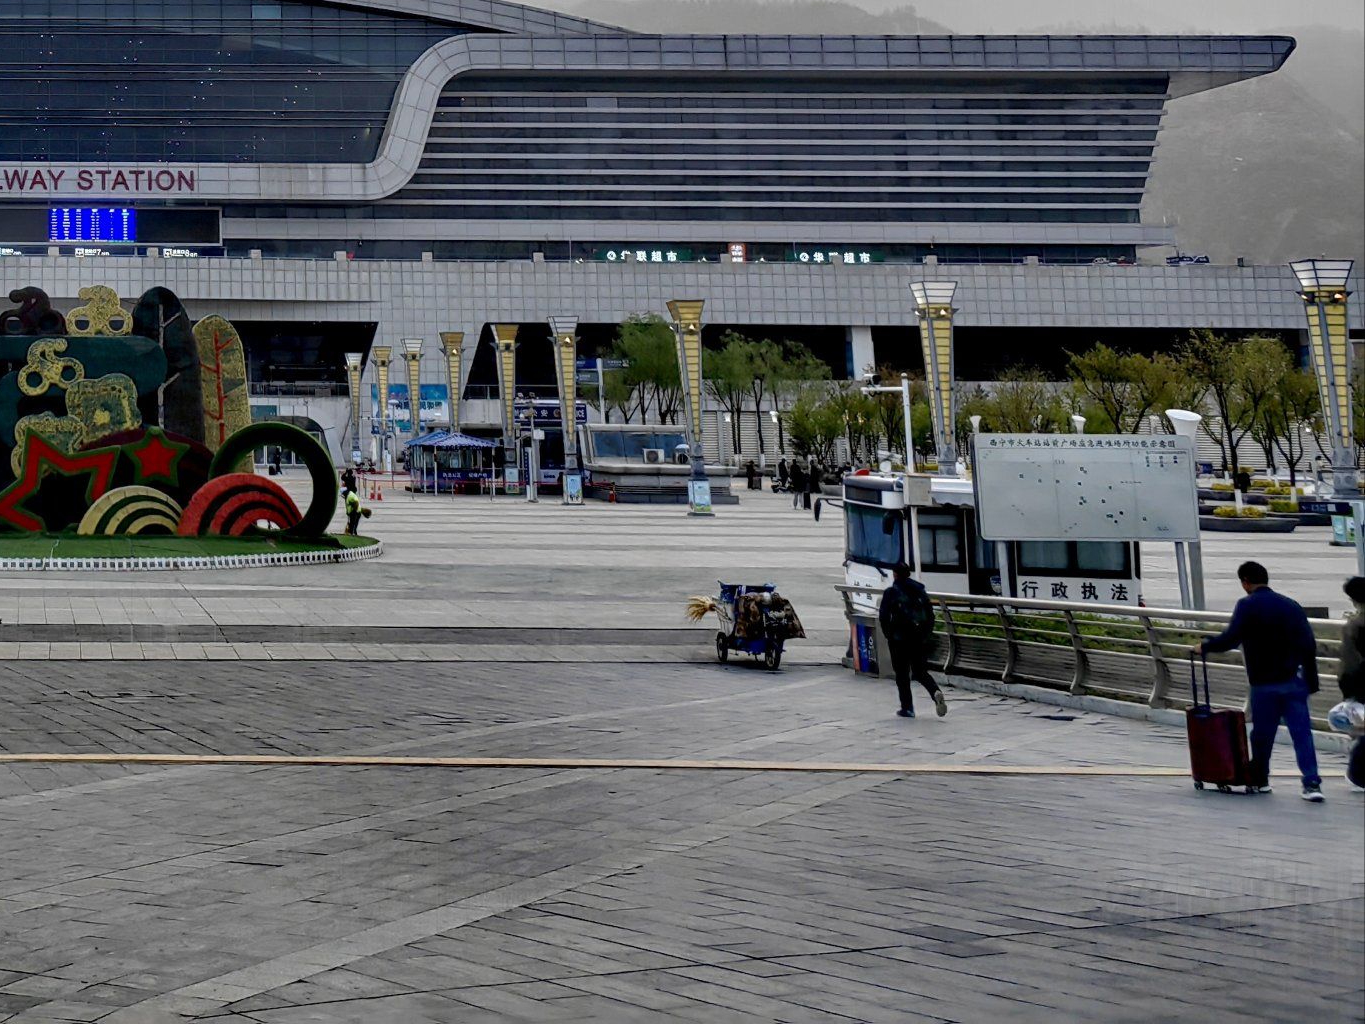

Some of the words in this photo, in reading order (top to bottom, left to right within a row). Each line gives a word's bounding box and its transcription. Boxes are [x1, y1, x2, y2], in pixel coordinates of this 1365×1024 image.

[77, 169, 195, 192] STATION
[813, 252, 871, 263] 华超市
[1021, 580, 1129, 601] 行政执法
